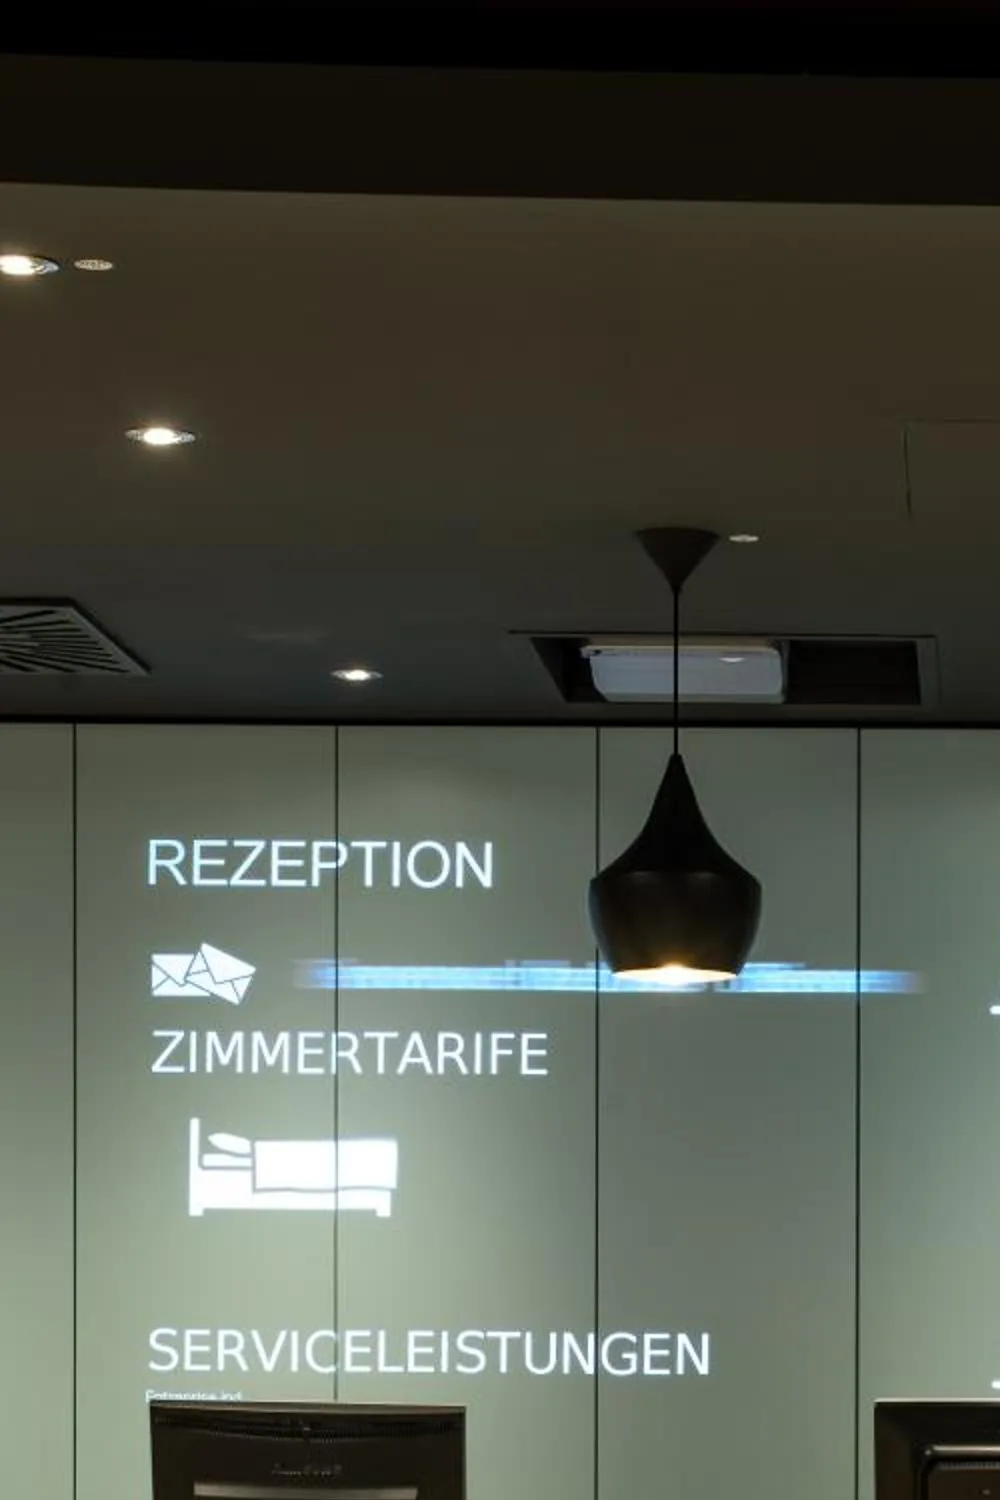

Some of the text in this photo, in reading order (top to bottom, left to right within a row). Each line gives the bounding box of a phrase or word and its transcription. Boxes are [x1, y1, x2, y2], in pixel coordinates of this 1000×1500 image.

[147, 839, 494, 888] REZEPTION
[151, 1031, 549, 1075] ZIMMERTARIFE
[147, 1328, 711, 1375] SERVICELEISTUNGEN
